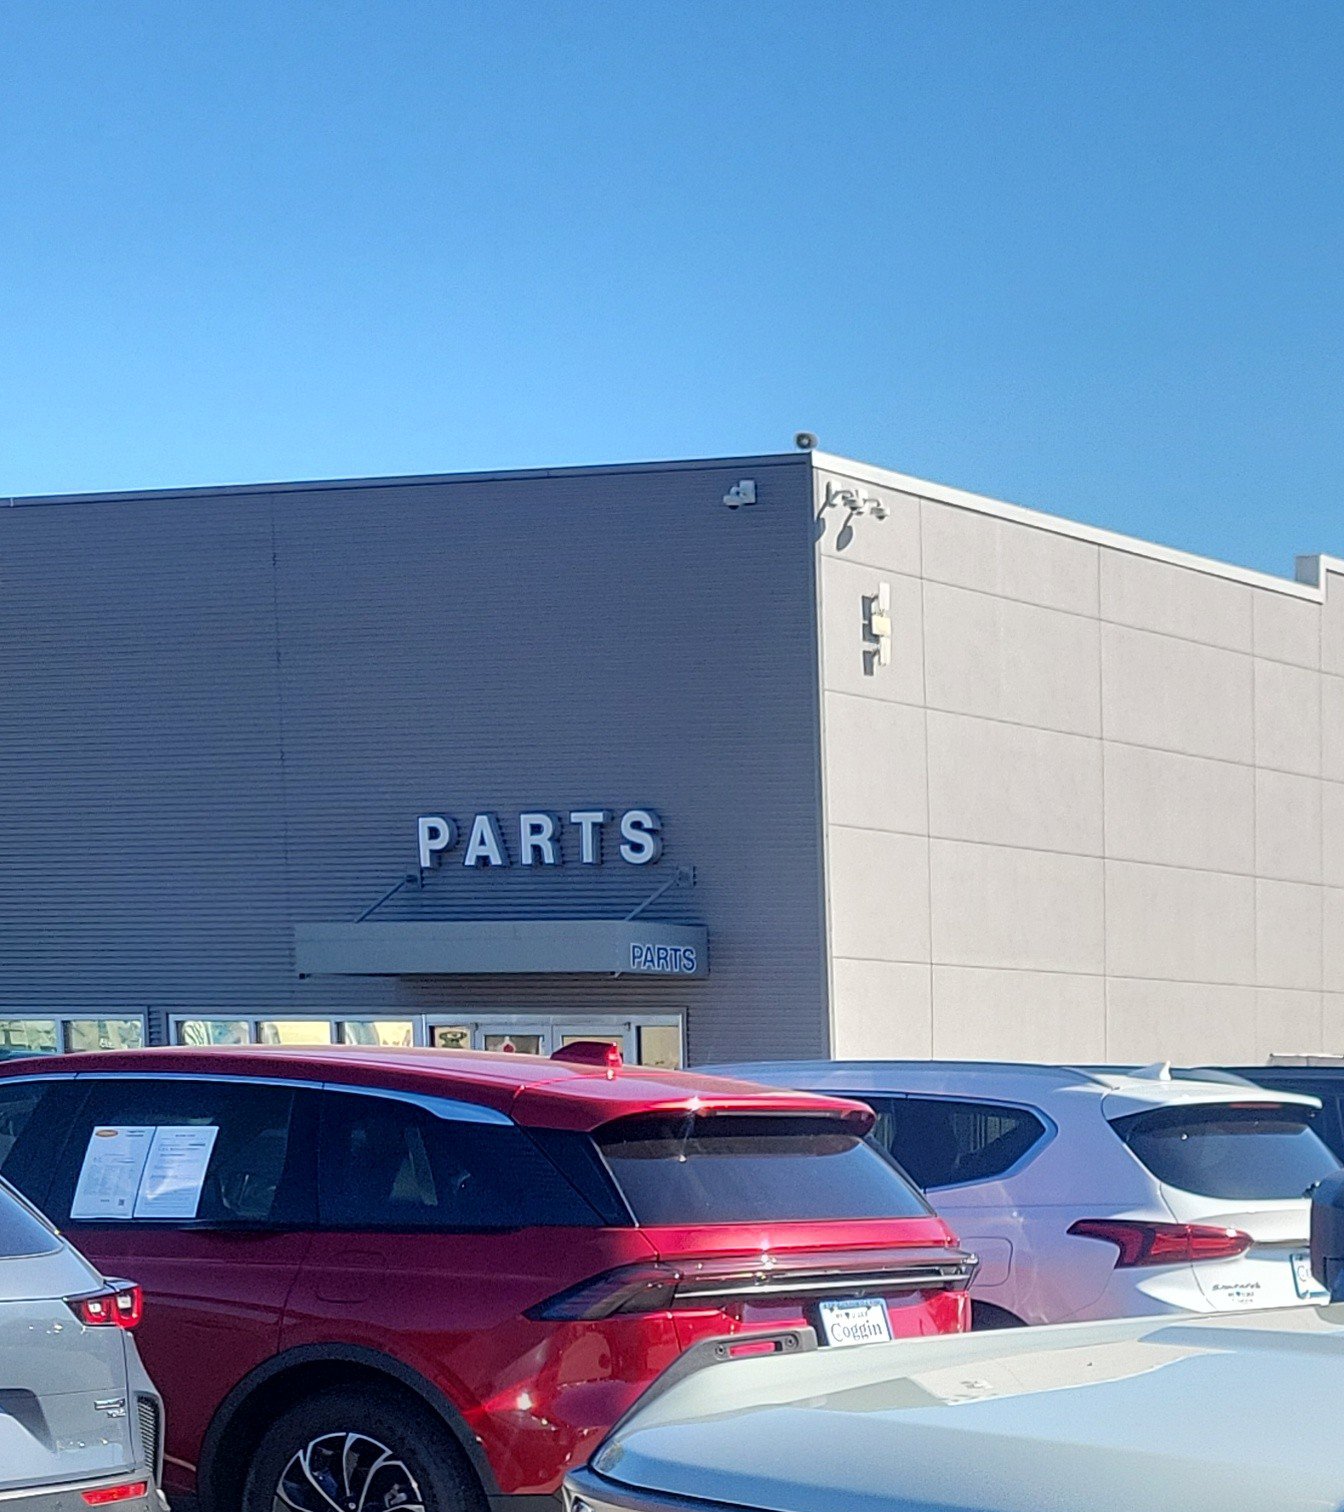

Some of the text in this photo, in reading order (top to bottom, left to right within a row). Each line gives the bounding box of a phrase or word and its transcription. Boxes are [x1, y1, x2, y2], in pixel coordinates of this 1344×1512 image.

[417, 809, 660, 868] PARTS
[630, 943, 697, 972] PARTS
[830, 1319, 883, 1342] Coggin
